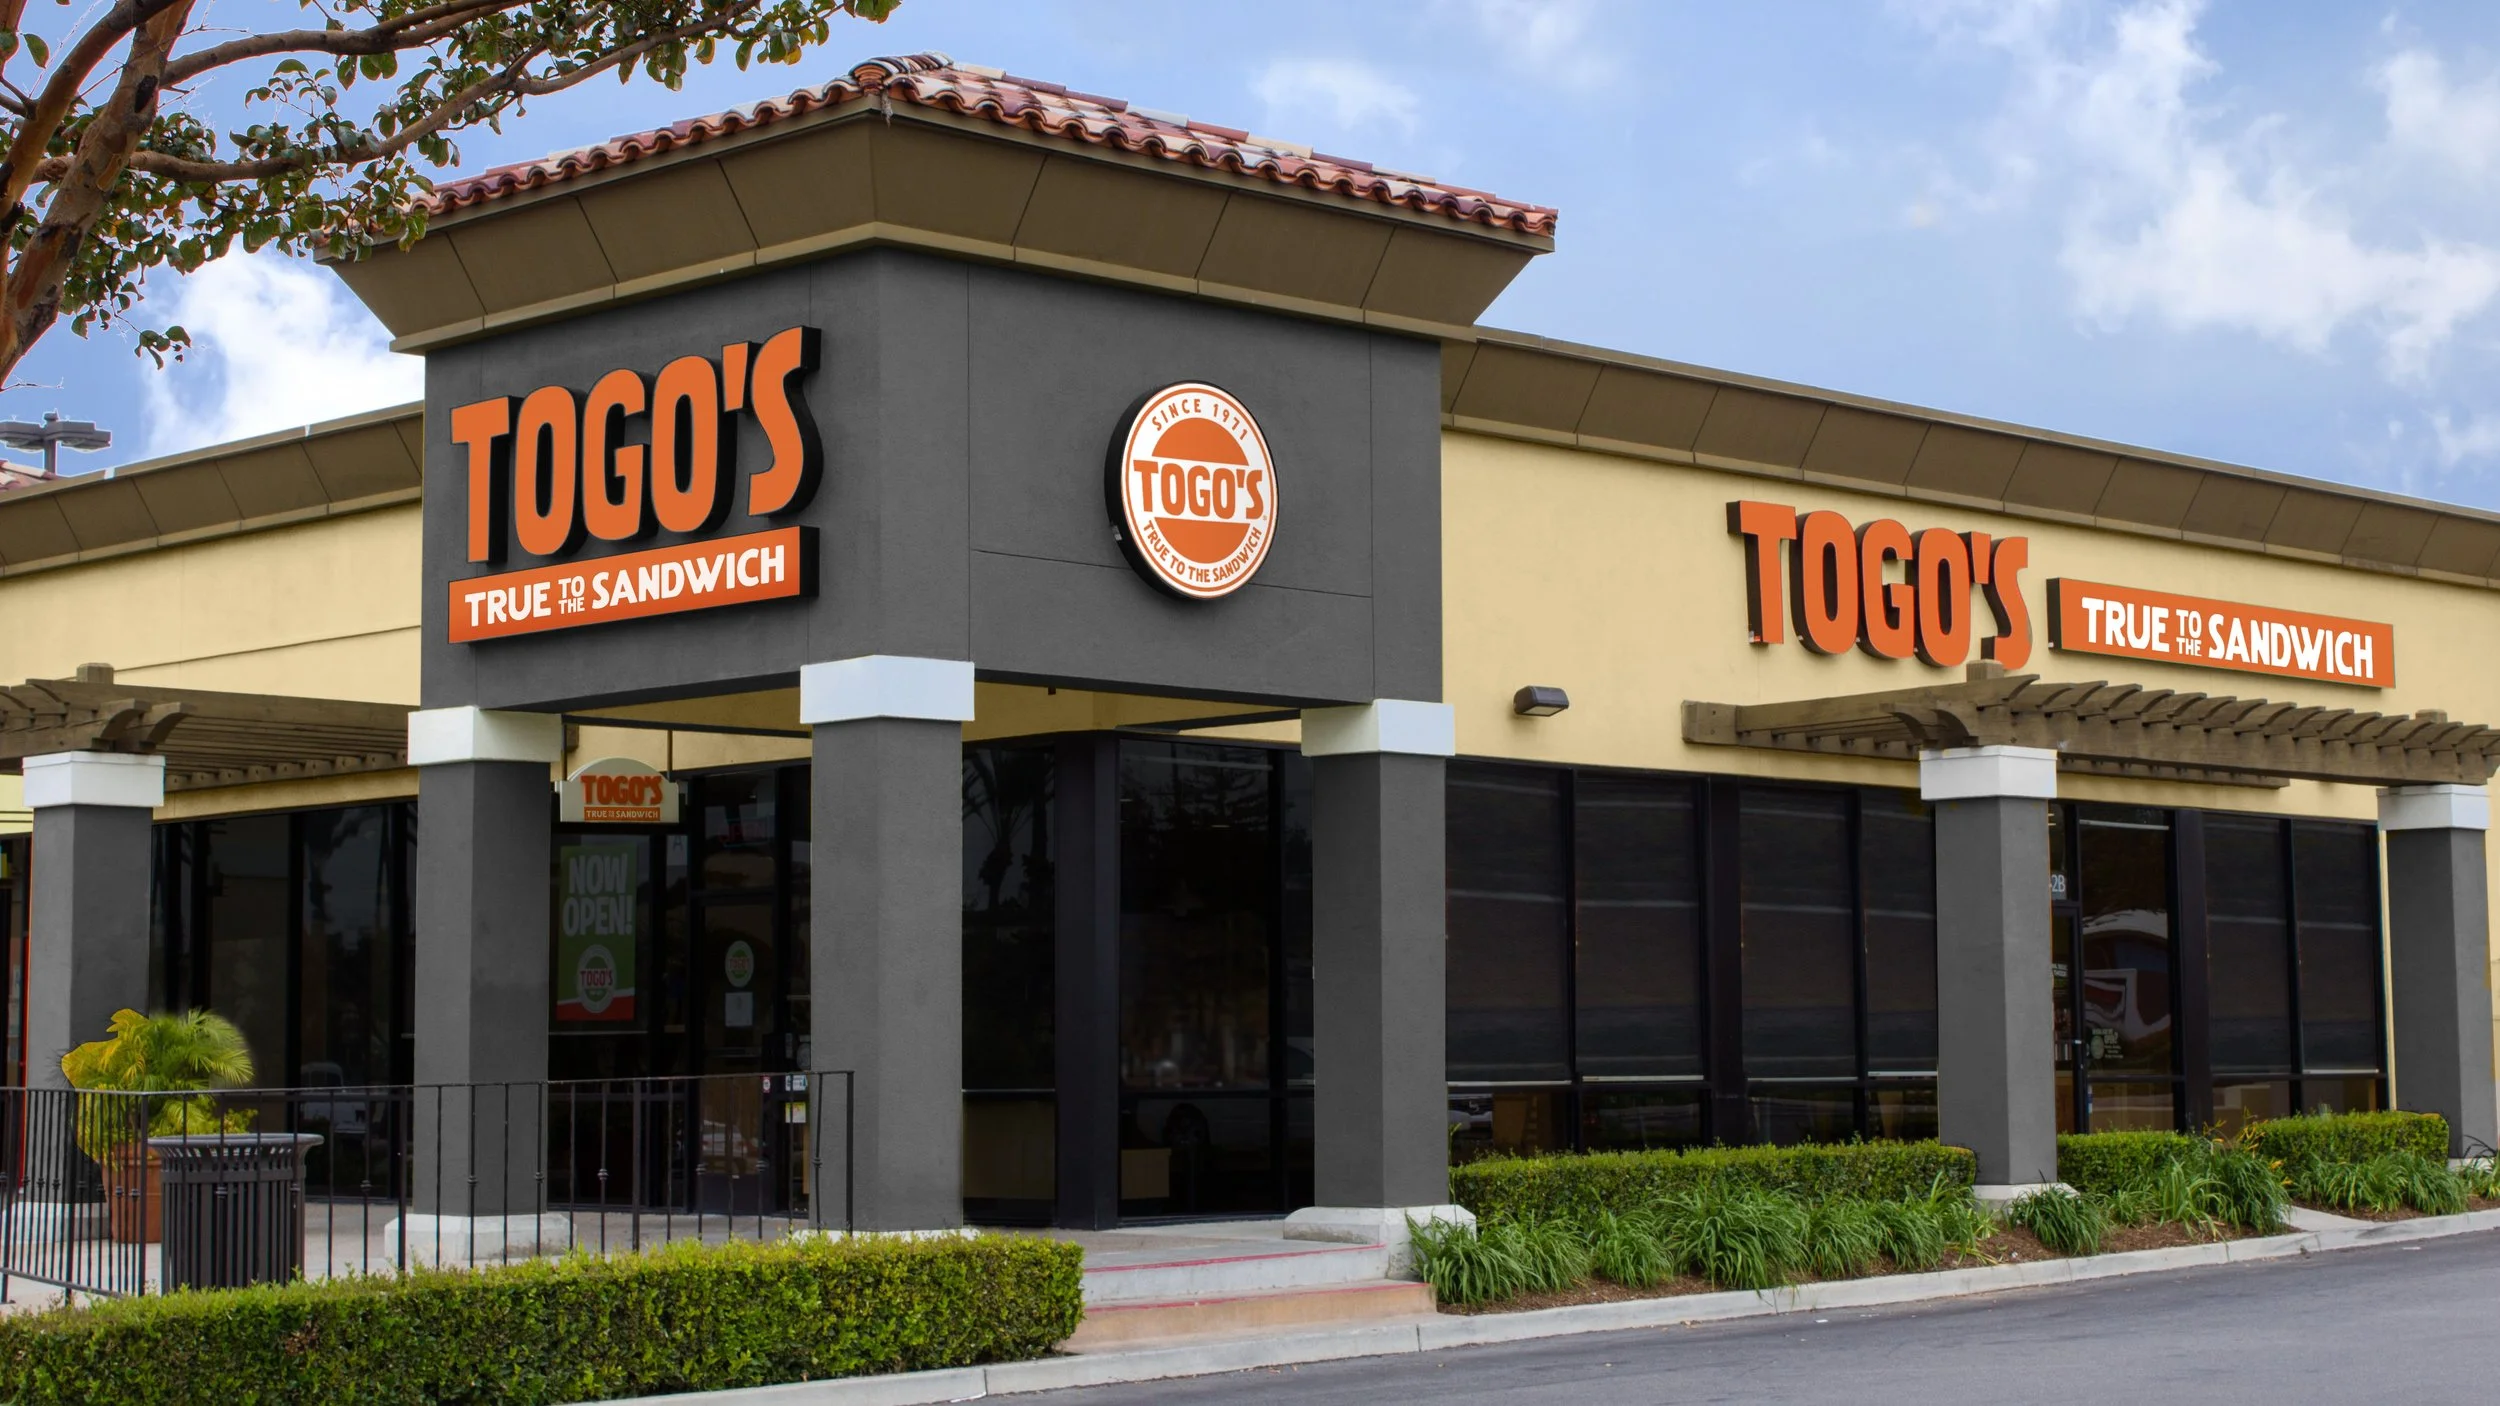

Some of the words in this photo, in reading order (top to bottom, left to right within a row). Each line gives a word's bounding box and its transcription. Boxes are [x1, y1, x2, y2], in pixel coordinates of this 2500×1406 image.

[1152, 398, 1201, 431] SINCE
[1213, 403, 1248, 441] 1971
[451, 326, 804, 564] TOGO'S
[1133, 459, 1264, 520] TOGO'S
[1143, 519, 1170, 561] TRUE
[1169, 555, 1185, 576] TO
[1188, 566, 1211, 583] THE
[1212, 527, 1262, 582] SANDWICH
[558, 575, 585, 599] TO
[592, 545, 785, 609] SANDWICH
[1737, 499, 2033, 671] TOGO'S
[465, 582, 552, 628] TRUE
[558, 597, 586, 616] THE
[2081, 597, 2170, 653] TRUE
[2176, 609, 2202, 639] TO
[2176, 636, 2203, 657] THE
[2208, 613, 2374, 679] SANDWICH
[581, 775, 664, 805] TOGO'S
[586, 810, 608, 818] TRUE
[615, 810, 659, 819] SANDWICH
[569, 853, 629, 895] NOW
[562, 895, 634, 937] OPEN!
[580, 970, 613, 987] TOGO'S
